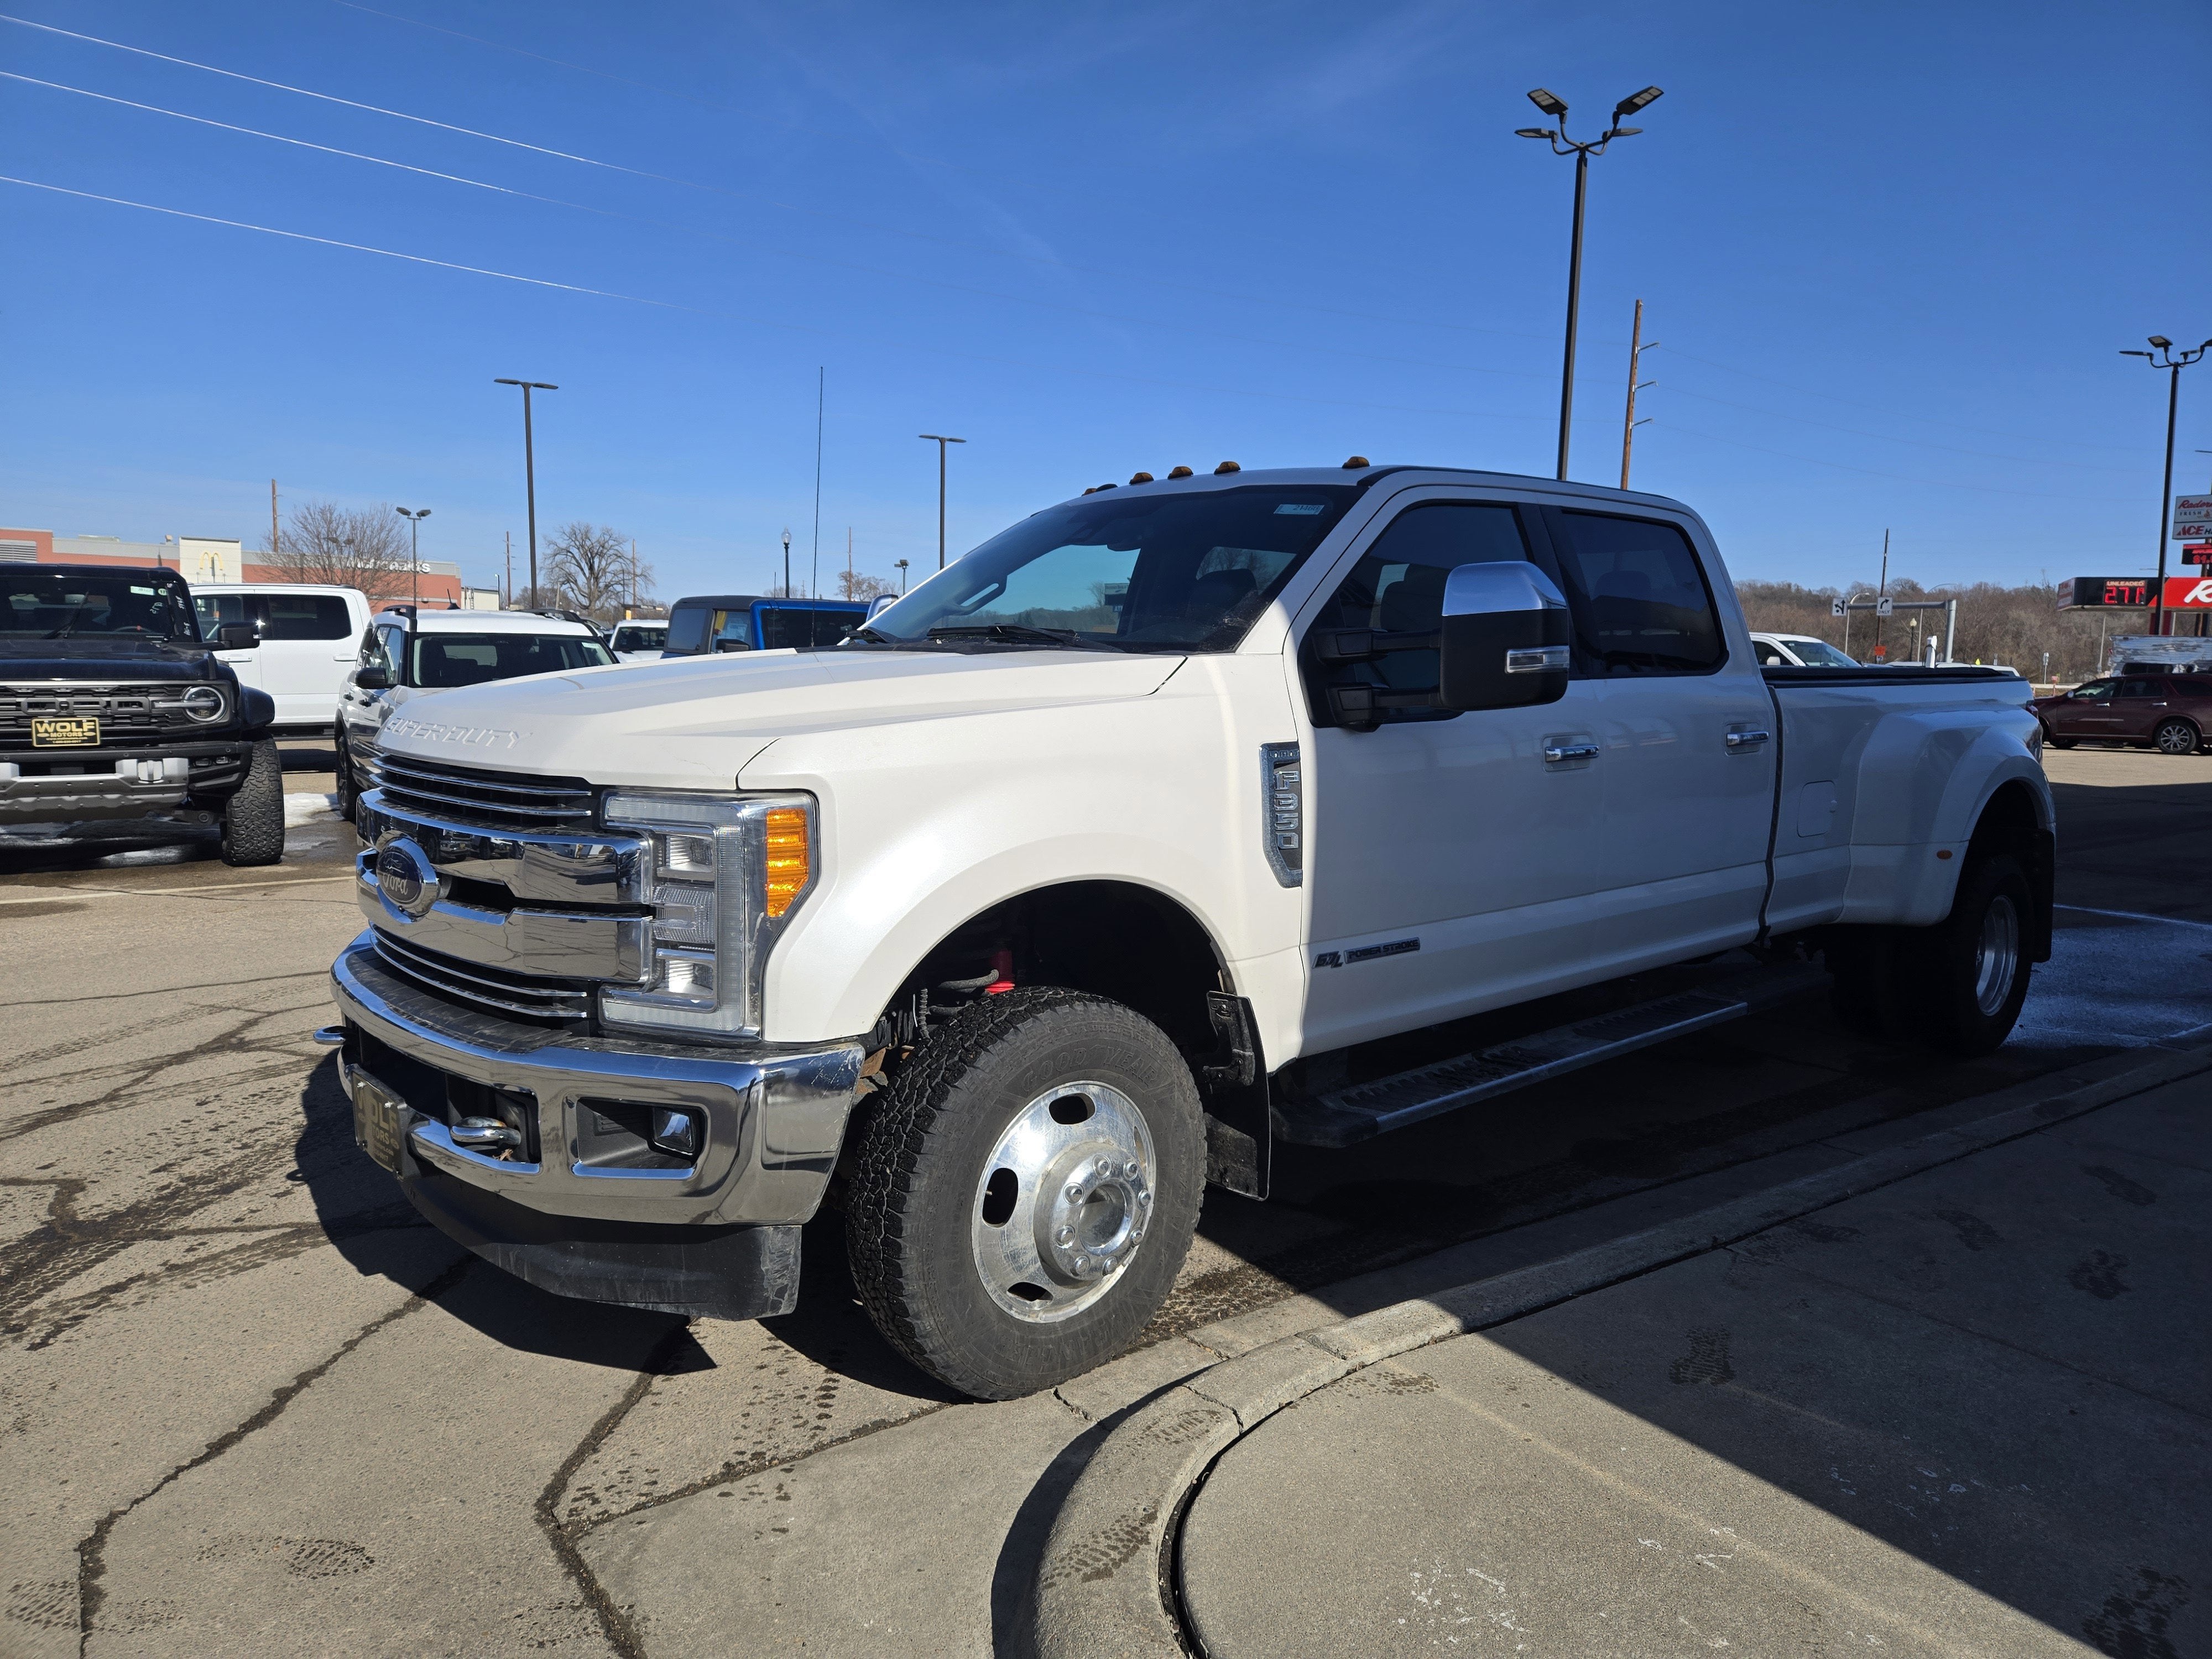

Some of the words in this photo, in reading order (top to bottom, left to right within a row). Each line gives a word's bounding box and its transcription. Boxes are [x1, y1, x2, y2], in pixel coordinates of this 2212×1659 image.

[2177, 525, 2205, 536] ACE
[36, 722, 95, 733] WOLF
[384, 717, 447, 741] SUPER
[442, 726, 519, 750] DUTY
[1348, 946, 1381, 959] POWER
[1383, 940, 1420, 952] STROKE
